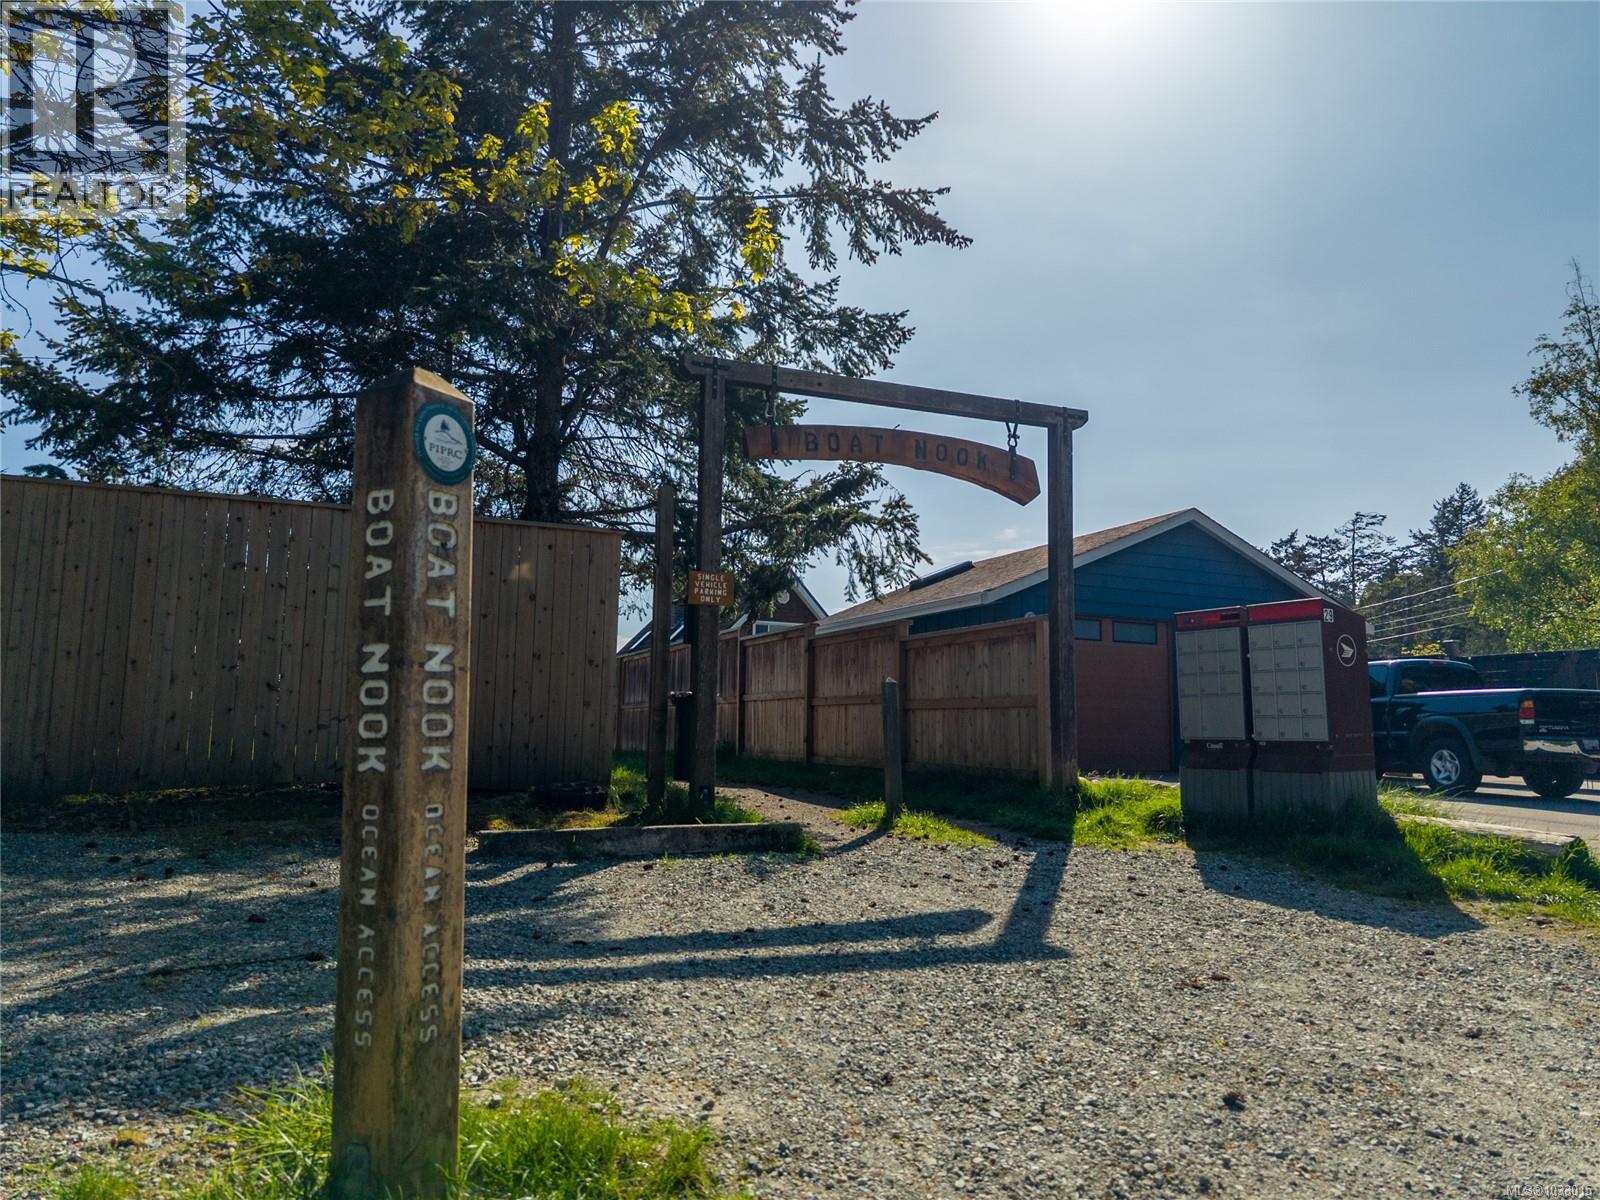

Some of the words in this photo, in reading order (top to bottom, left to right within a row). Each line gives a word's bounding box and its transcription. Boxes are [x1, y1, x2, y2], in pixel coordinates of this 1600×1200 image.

[429, 442, 463, 460] PIPRC
[803, 431, 884, 454] BOAT
[914, 438, 989, 471] NOOK
[364, 488, 394, 616] BOAT
[694, 588, 727, 596] PARKING
[695, 581, 727, 589] VEHICLE
[697, 573, 725, 581] SINGLE
[357, 643, 390, 772] NOOK
[421, 643, 454, 771] NOOK
[359, 804, 379, 906] OCEAN
[423, 803, 444, 904] OCEAN
[354, 924, 375, 1047] ACCESS
[420, 923, 441, 1043] ACCESS
